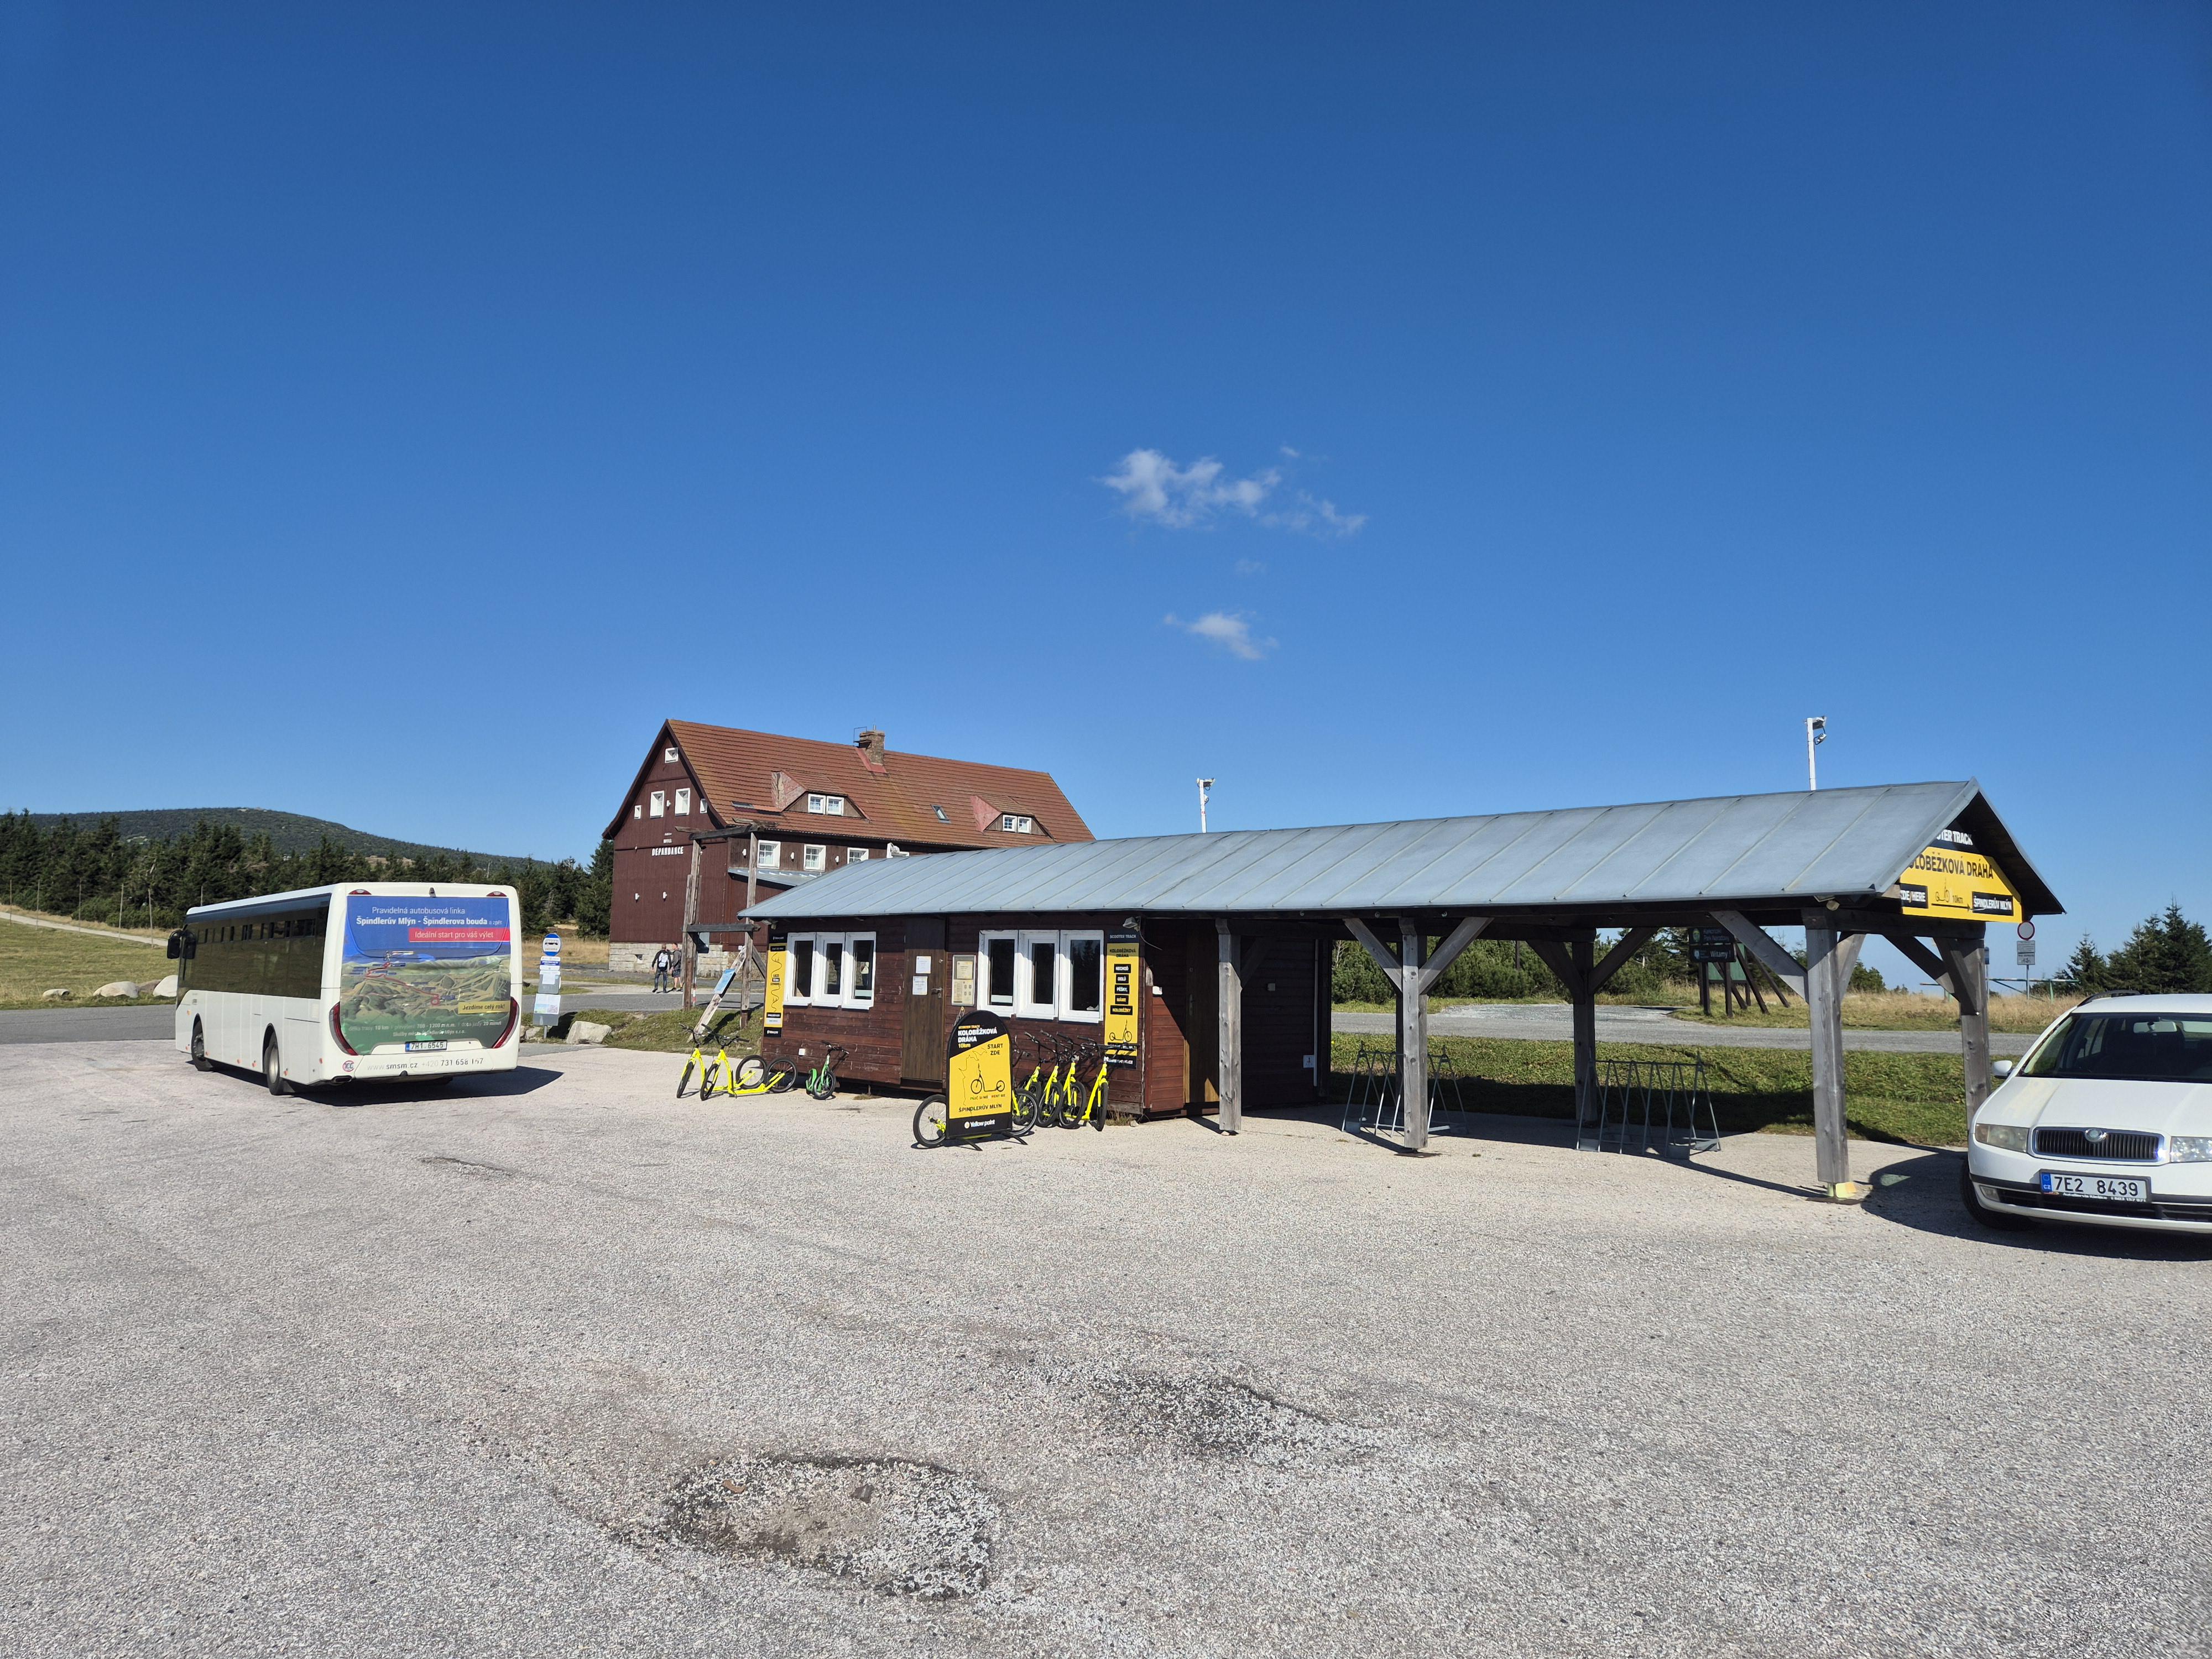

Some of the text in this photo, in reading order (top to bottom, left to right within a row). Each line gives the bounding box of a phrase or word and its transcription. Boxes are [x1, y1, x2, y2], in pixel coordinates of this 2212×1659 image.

[1953, 831, 1973, 845] TRACK
[1909, 852, 1994, 879] LOBĚŽKOVÁ DRÁHA
[2000, 899, 2012, 911] MLÝN
[356, 915, 397, 926] Špindlerův
[398, 917, 416, 926] Mlýn
[422, 916, 465, 926] Špindlerova
[958, 1027, 998, 1036] KOLOBĚŽKOVÁ
[958, 1104, 988, 1113] ŠPINDLERŮV
[984, 1119, 995, 1127] point
[2054, 1176, 2138, 1197] 7E2 8439
